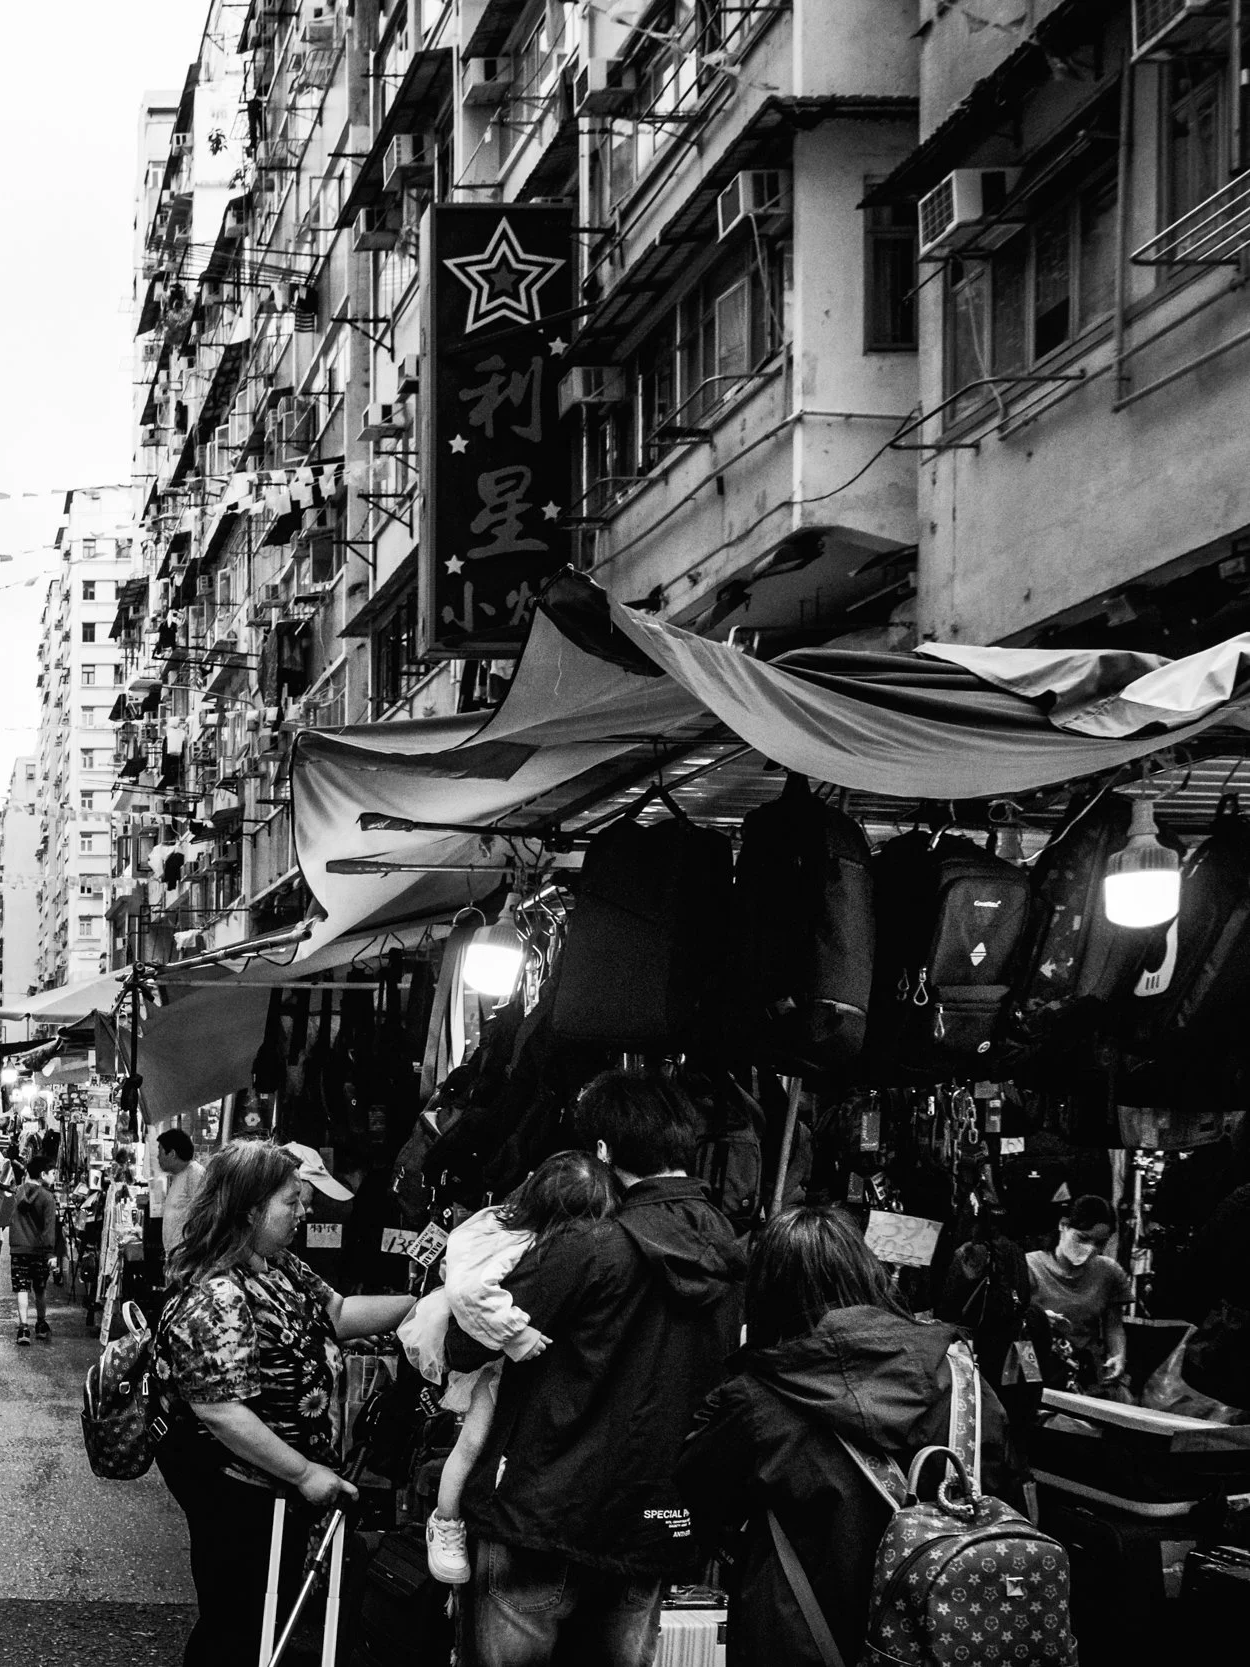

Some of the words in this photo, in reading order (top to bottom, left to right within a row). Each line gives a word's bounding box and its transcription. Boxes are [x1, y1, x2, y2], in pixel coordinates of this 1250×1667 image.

[459, 354, 549, 558] 利星
[421, 1240, 444, 1265] DAKAR
[643, 1509, 683, 1519] SPECIAL
